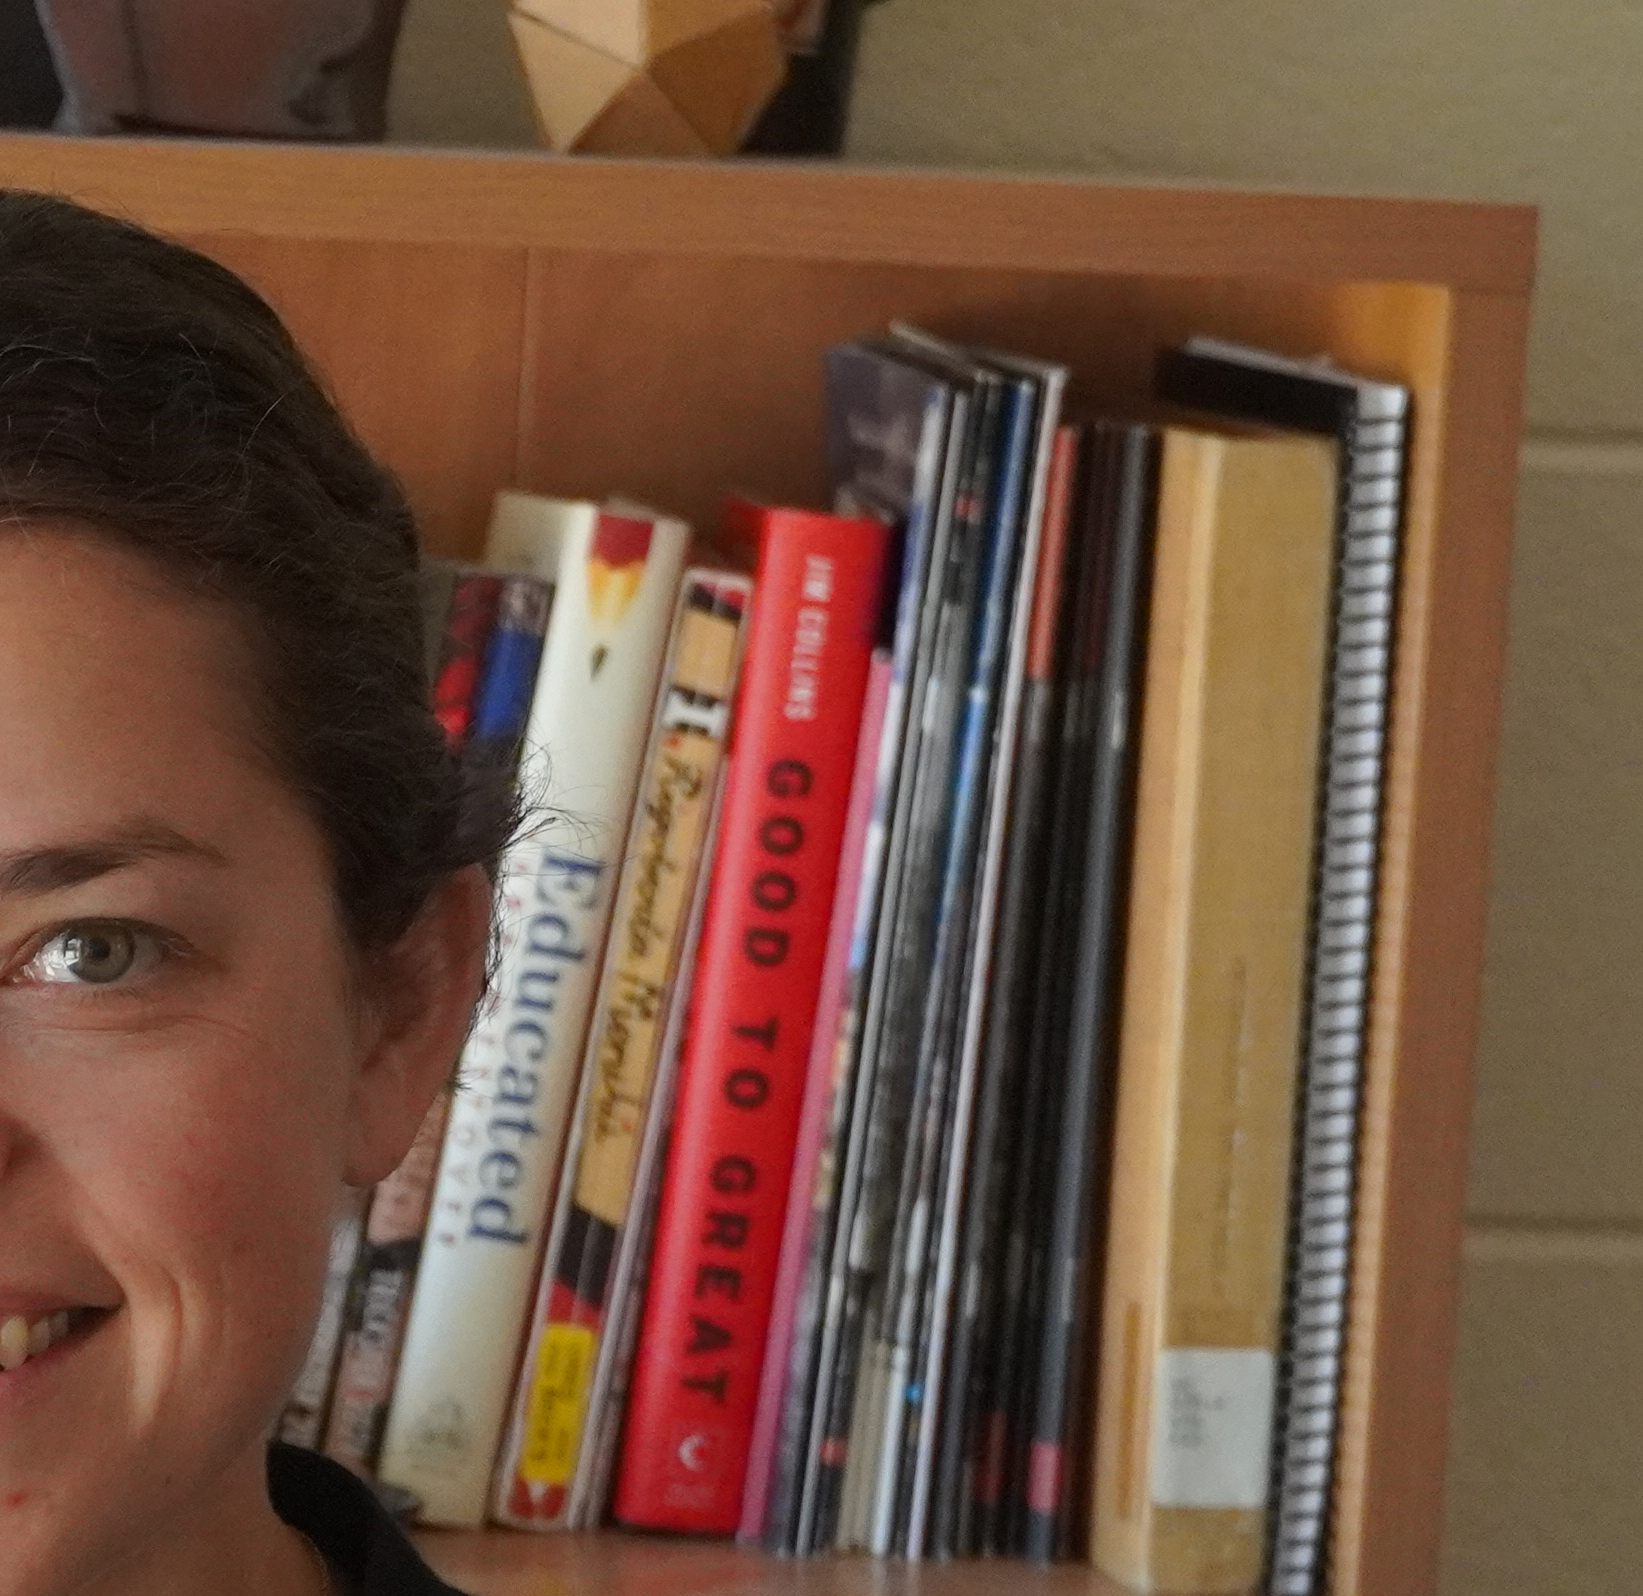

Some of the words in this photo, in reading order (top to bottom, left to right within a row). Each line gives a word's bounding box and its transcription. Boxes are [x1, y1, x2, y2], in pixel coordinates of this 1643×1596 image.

[744, 758, 815, 968] GOOD
[468, 853, 607, 1246] Educated
[725, 1017, 778, 1110] TO
[685, 1153, 758, 1405] GREAT
